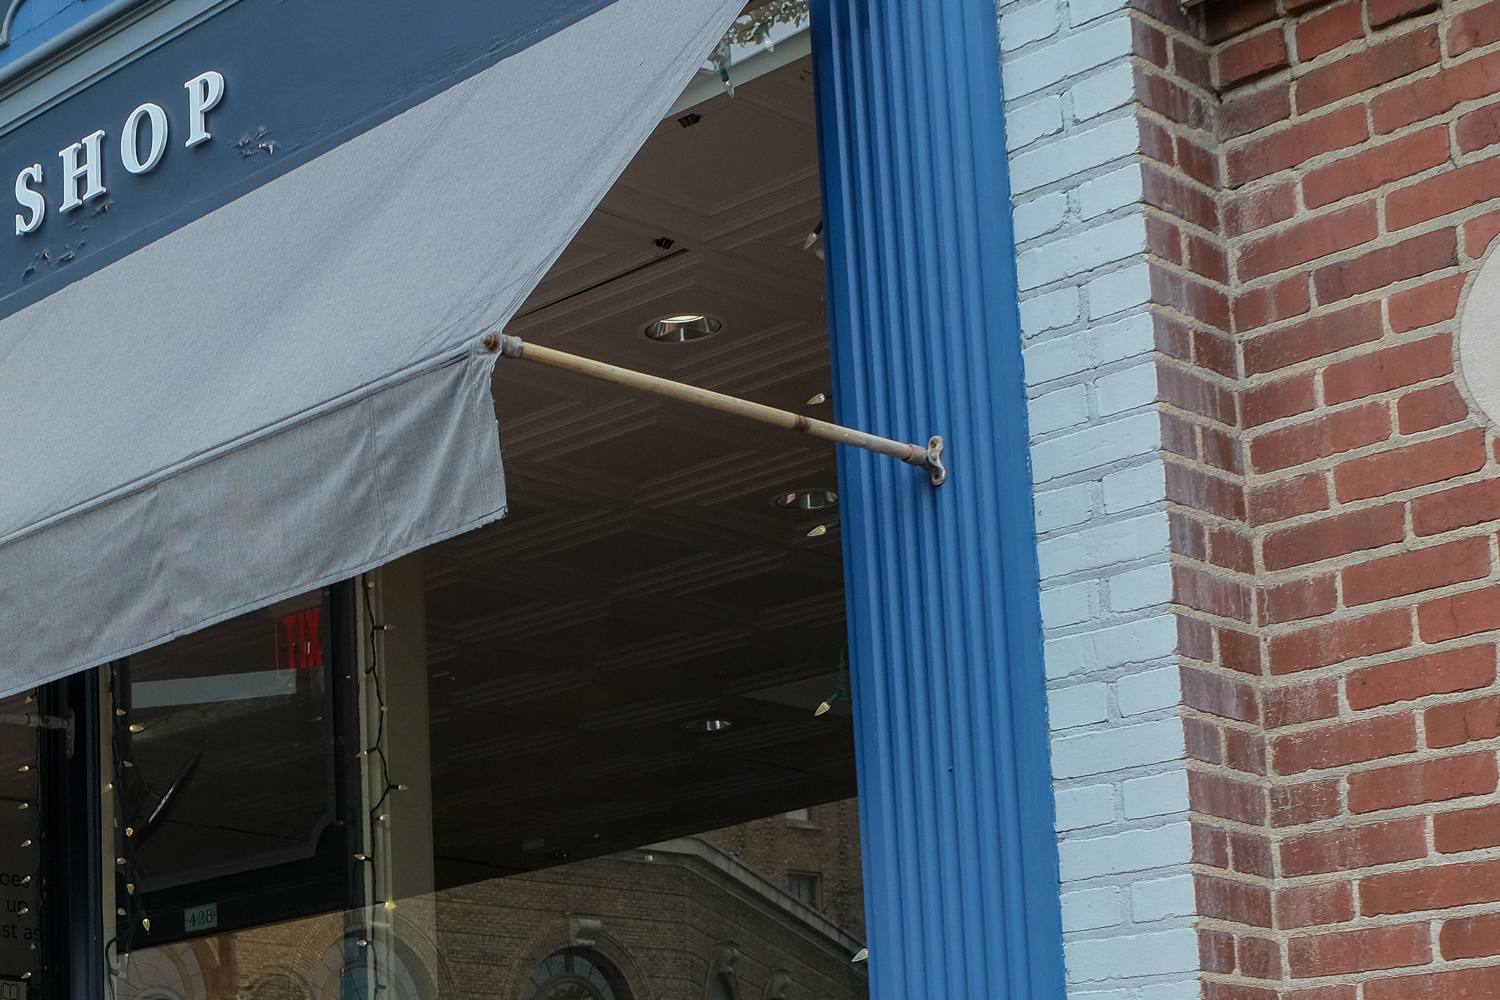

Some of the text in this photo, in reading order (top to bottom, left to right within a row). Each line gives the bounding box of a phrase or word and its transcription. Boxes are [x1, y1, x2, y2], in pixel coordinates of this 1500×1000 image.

[15, 70, 225, 236] SHOP
[7, 897, 29, 919] up
[23, 925, 41, 941] as
